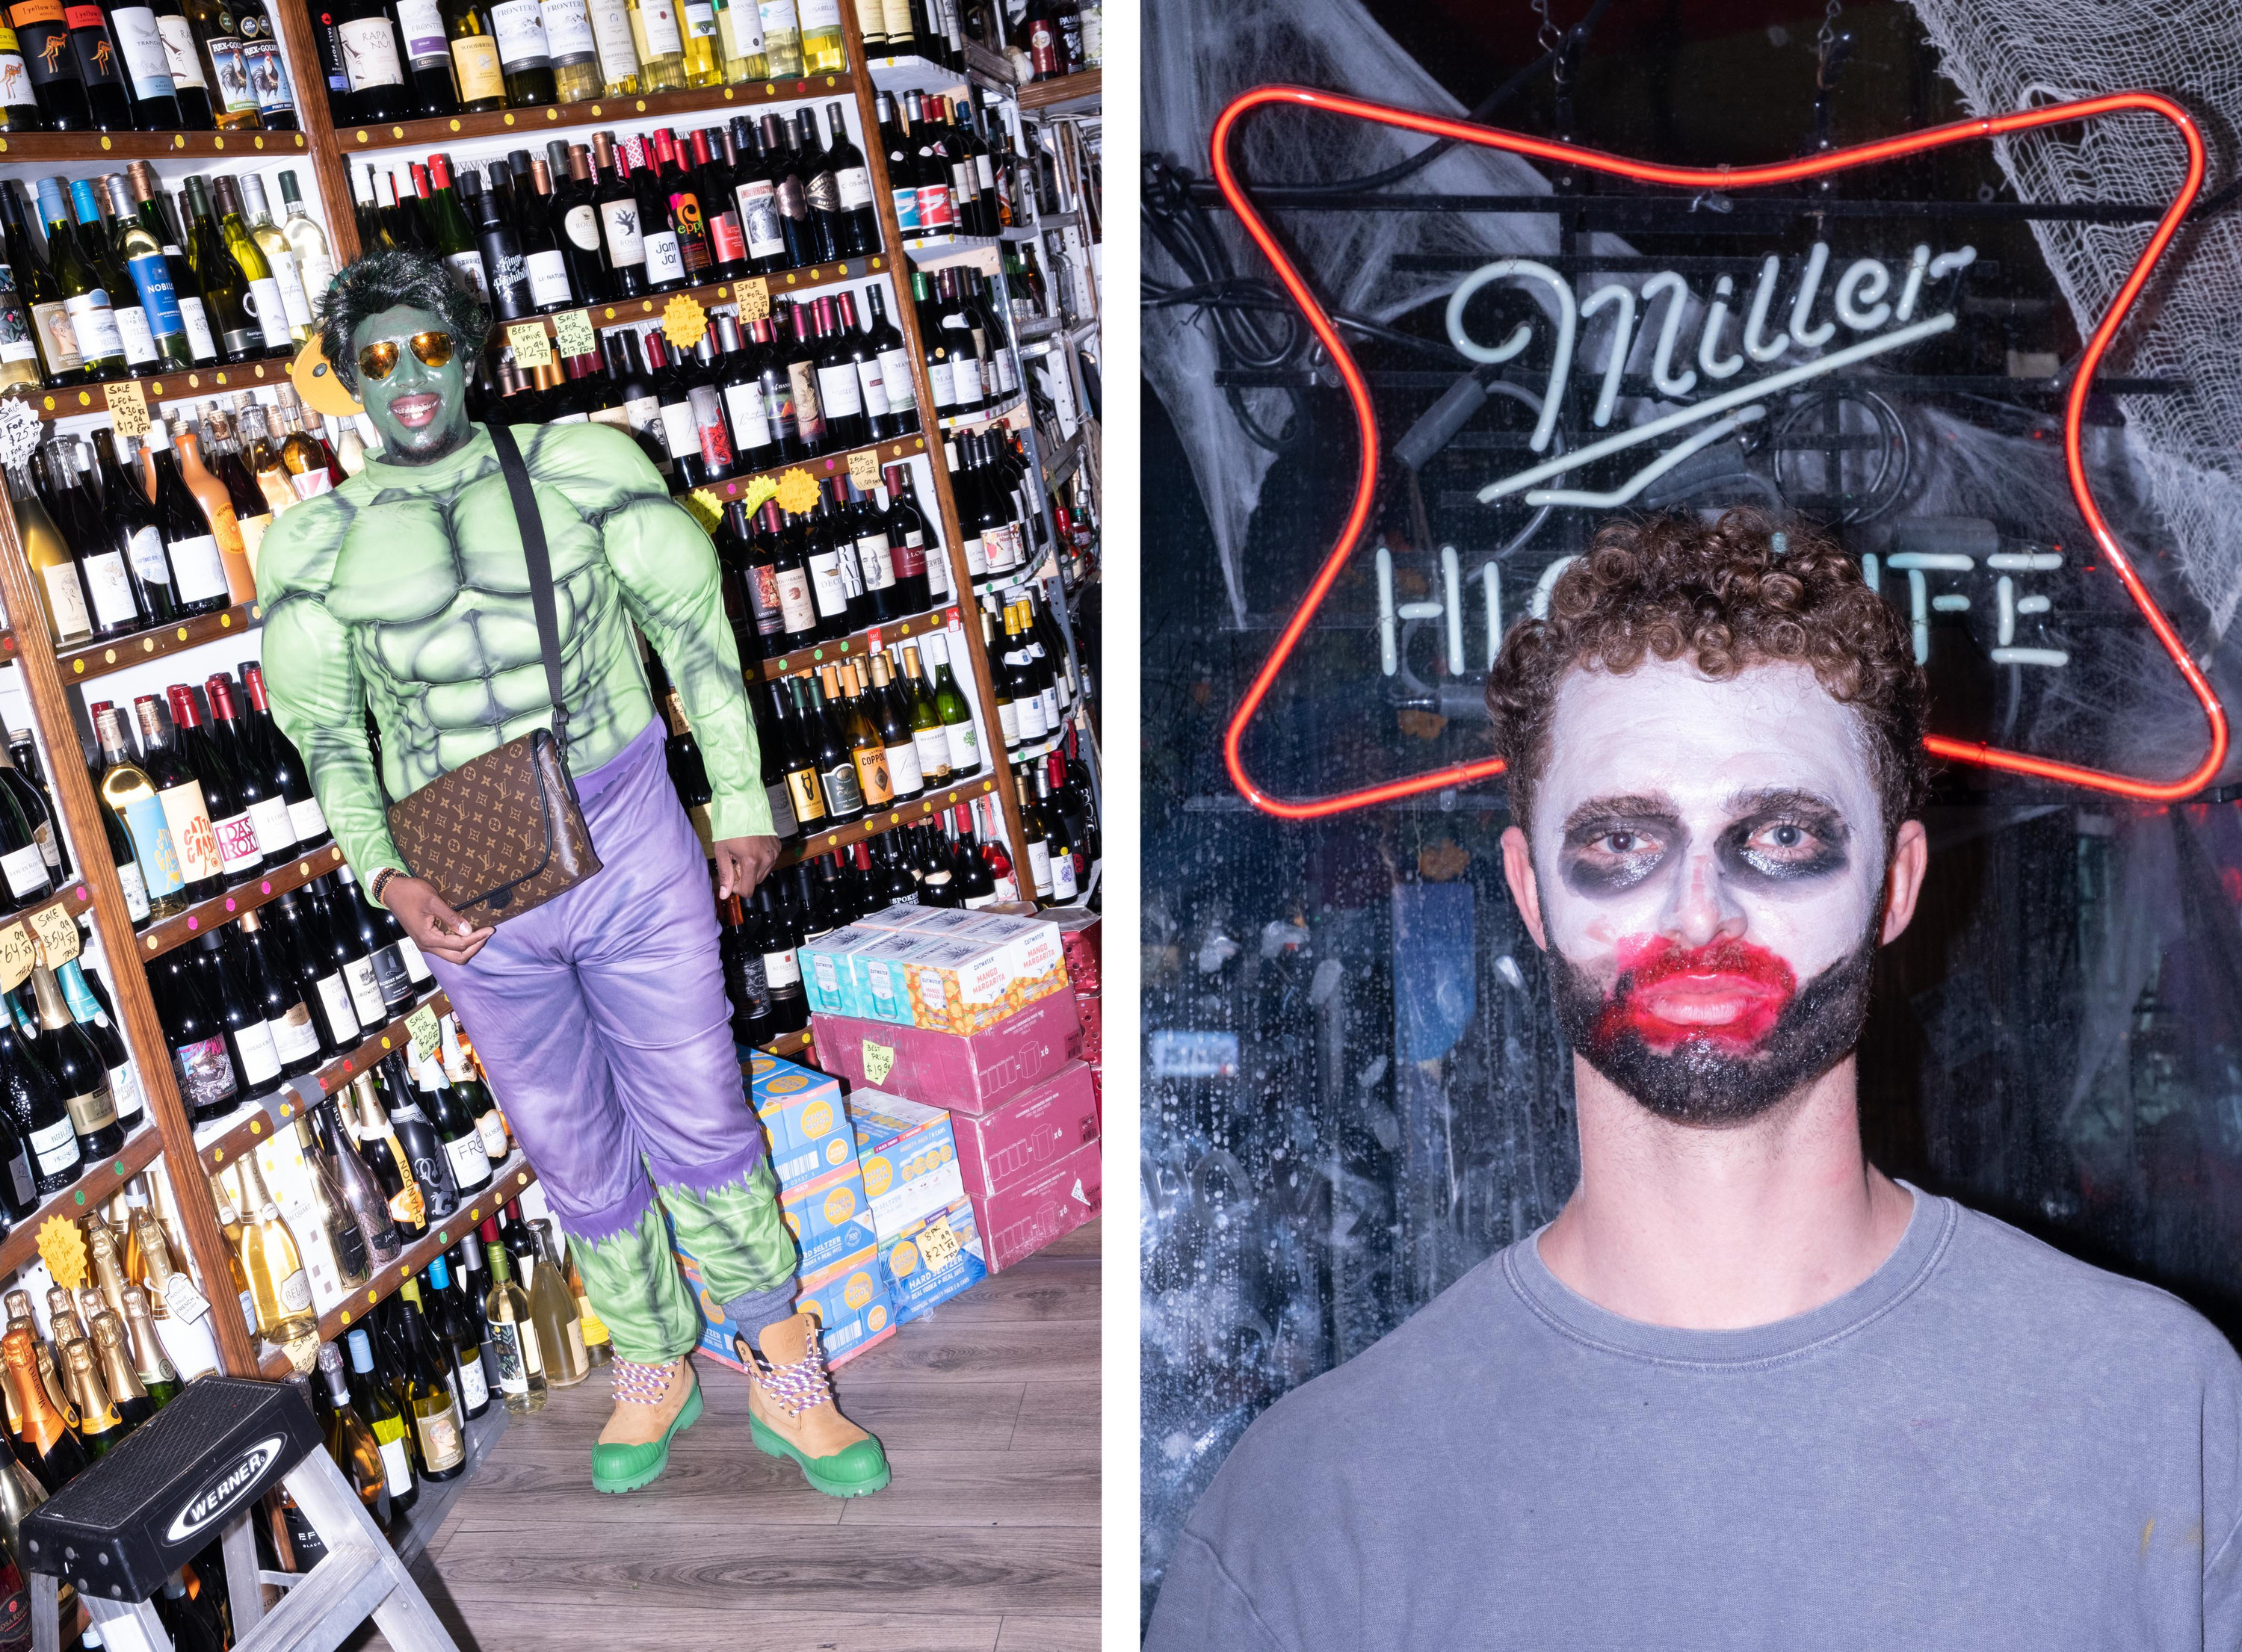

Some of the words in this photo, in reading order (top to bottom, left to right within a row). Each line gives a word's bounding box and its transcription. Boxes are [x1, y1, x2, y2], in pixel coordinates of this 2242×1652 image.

[1058, 16, 1080, 25] PAMA
[362, 31, 389, 40] RAPA
[331, 45, 339, 66] POPPY
[655, 241, 676, 255] jam
[661, 253, 677, 266] jar
[739, 294, 747, 303] 2
[746, 290, 763, 299] FOR
[558, 312, 578, 324] SALE
[511, 324, 532, 335] BEST
[558, 326, 566, 334] 2
[564, 321, 582, 331] FOR
[1446, 242, 1977, 452] Miller
[108, 383, 131, 395] SALE
[110, 397, 119, 409] 2
[117, 395, 138, 406] FOR
[6, 418, 24, 433] FOR
[10, 445, 22, 457] FOR
[226, 818, 254, 841] DAS
[38, 907, 60, 928] SALE
[966, 918, 1001, 935] CUTWATER
[44, 930, 66, 950] $54
[1023, 932, 1045, 945] CUTWATER
[915, 941, 951, 959] CUTWATER
[1028, 943, 1048, 957] MANGO
[973, 956, 995, 971] CUTWATER
[1023, 949, 1056, 969] MARGARITA
[921, 977, 942, 985] CUTWATER
[977, 967, 998, 983] MANGO
[972, 973, 1006, 994] MARGARITA
[410, 1011, 426, 1027] SALE
[418, 1020, 431, 1035] FOR
[871, 1053, 890, 1062] PRICE
[806, 1110, 827, 1122] HIGH
[806, 1118, 830, 1131] NOON
[934, 1127, 946, 1137] CANS
[1053, 1127, 1063, 1140] x6
[878, 1142, 888, 1151] BLACK
[887, 1138, 898, 1148] CHERRY
[865, 1164, 887, 1178] HIGH
[865, 1171, 889, 1188] NOON
[401, 1158, 424, 1225] CHANDON
[794, 1183, 809, 1194] PEACH
[829, 1195, 850, 1209] HIGH
[827, 1201, 853, 1218] NOON
[812, 1236, 842, 1255] SELTZER
[924, 1243, 945, 1263] $21
[909, 1271, 932, 1290] HARD
[910, 1290, 923, 1300] REAL
[922, 1282, 938, 1294] VODKA
[942, 1273, 954, 1283] REAL
[175, 1295, 187, 1306] TRUE
[176, 1297, 195, 1314] FRENCH
[292, 1334, 314, 1352] SALE
[28, 1364, 46, 1410] MIONETTO
[190, 1451, 263, 1523] WERNER
[302, 1541, 322, 1549] BLACK
